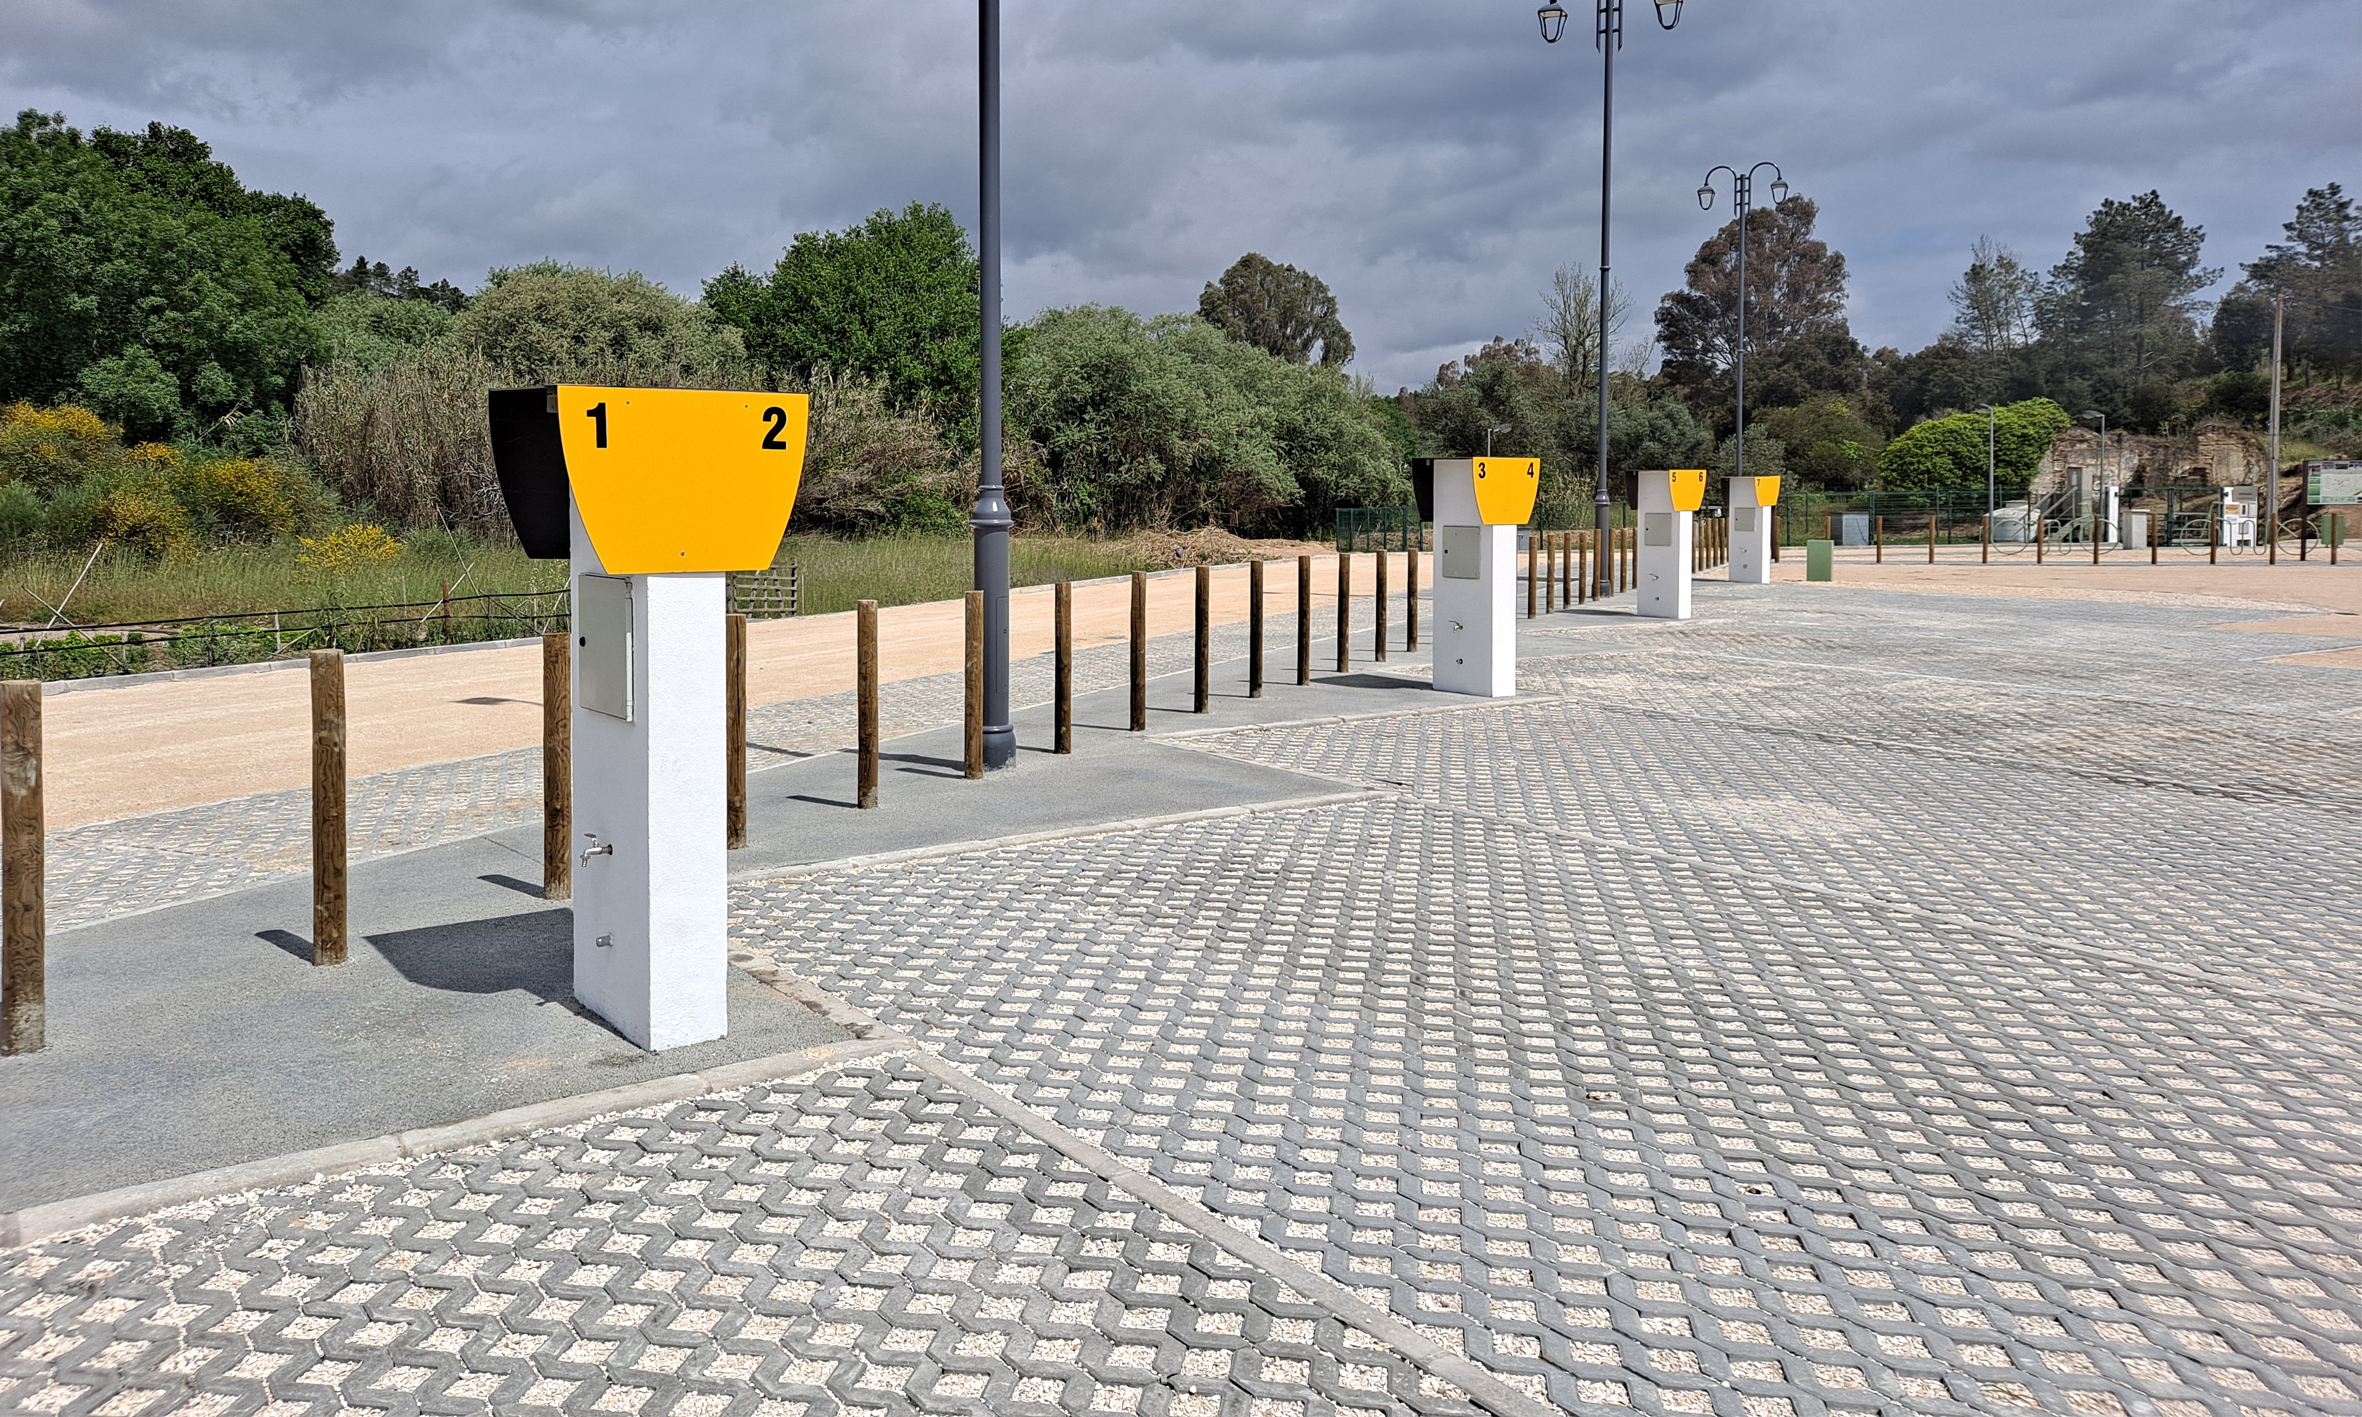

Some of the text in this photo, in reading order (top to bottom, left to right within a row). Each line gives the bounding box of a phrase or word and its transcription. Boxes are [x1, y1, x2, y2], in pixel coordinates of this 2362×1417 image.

[586, 402, 608, 449] 1
[762, 406, 787, 450] 2
[1478, 462, 1486, 479] 3
[1527, 462, 1535, 478] 4
[1671, 472, 1677, 482] 5
[1698, 472, 1704, 482] 6
